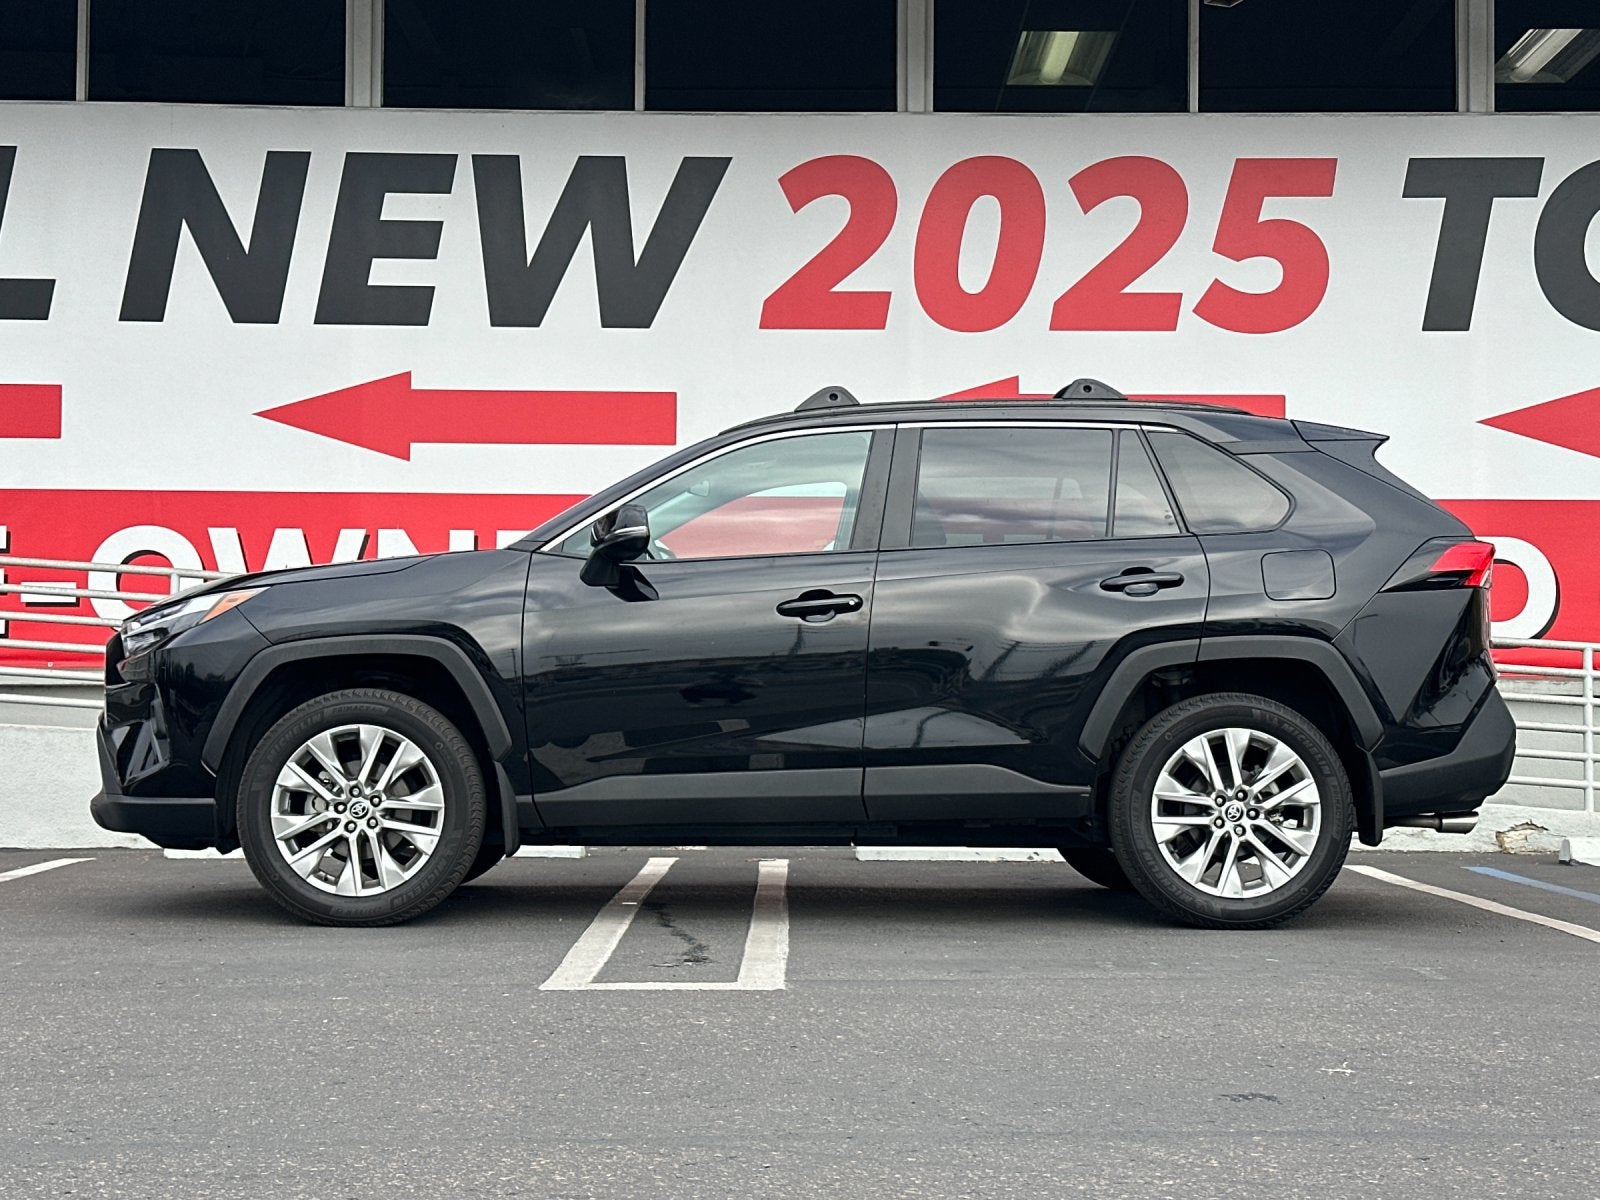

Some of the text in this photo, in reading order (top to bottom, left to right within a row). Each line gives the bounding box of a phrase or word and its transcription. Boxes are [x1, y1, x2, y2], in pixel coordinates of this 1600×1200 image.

[119, 147, 733, 329] NEW
[759, 154, 1338, 333] 2025
[1282, 722, 1333, 776] MICHELIN
